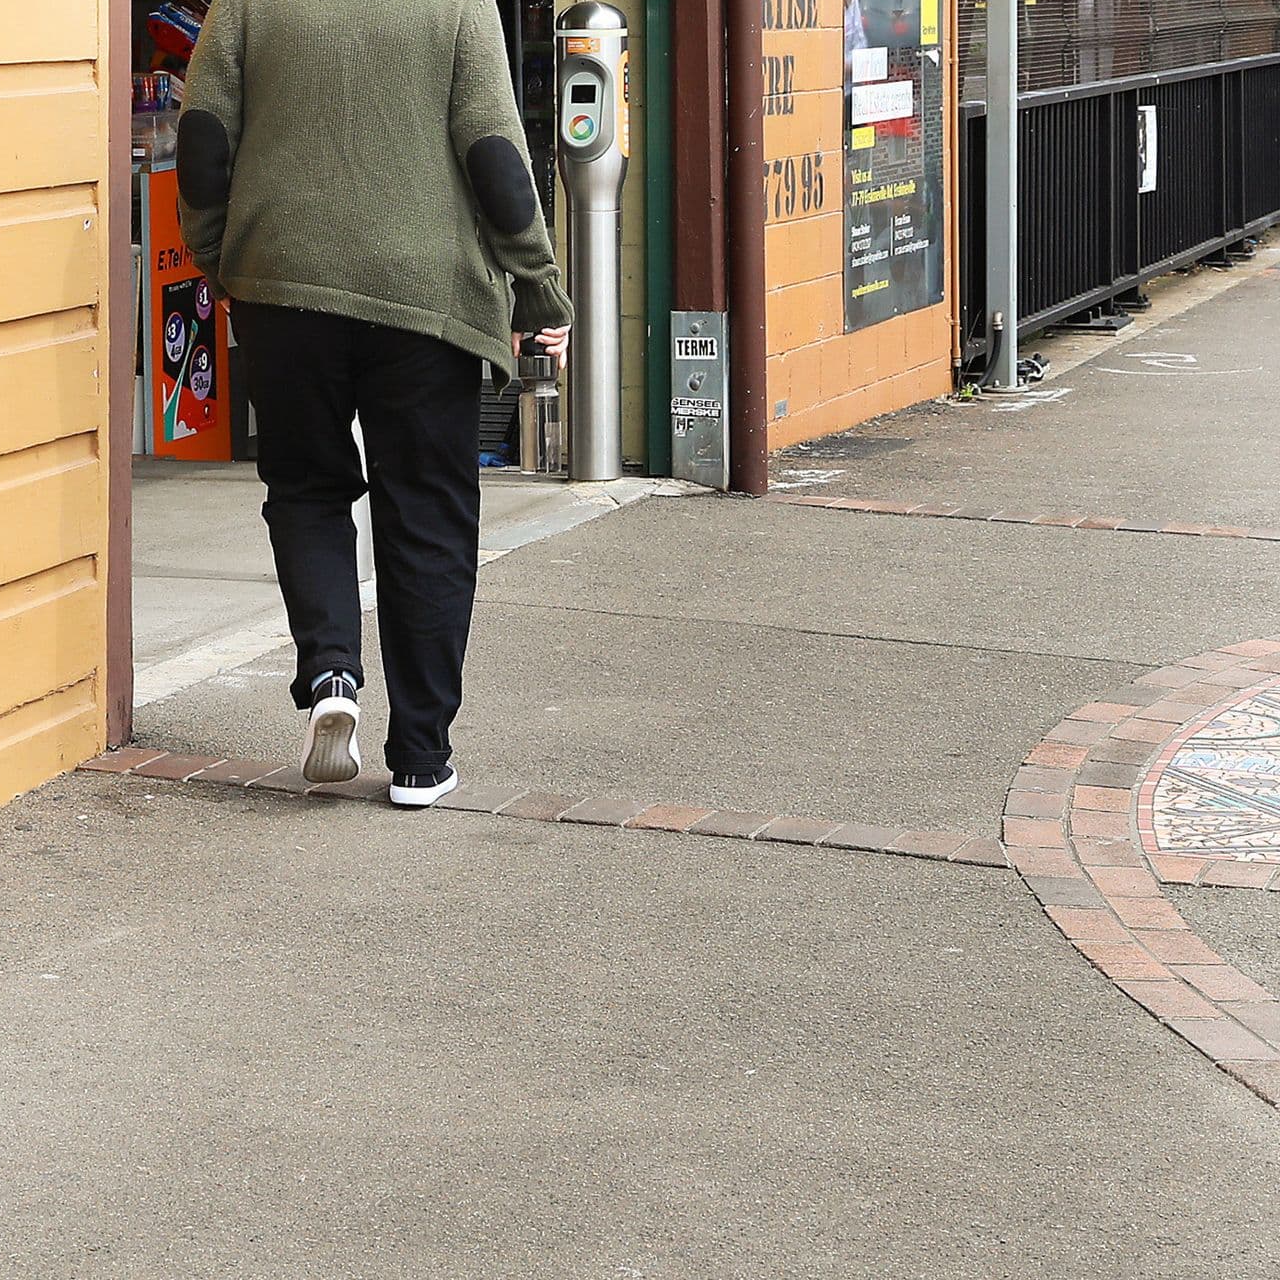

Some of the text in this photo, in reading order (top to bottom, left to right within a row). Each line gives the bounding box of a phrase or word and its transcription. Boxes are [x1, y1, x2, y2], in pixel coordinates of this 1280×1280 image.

[199, 287, 209, 305] $1
[167, 324, 177, 338] $3
[677, 339, 715, 356] TERM1
[198, 352, 208, 370] $9
